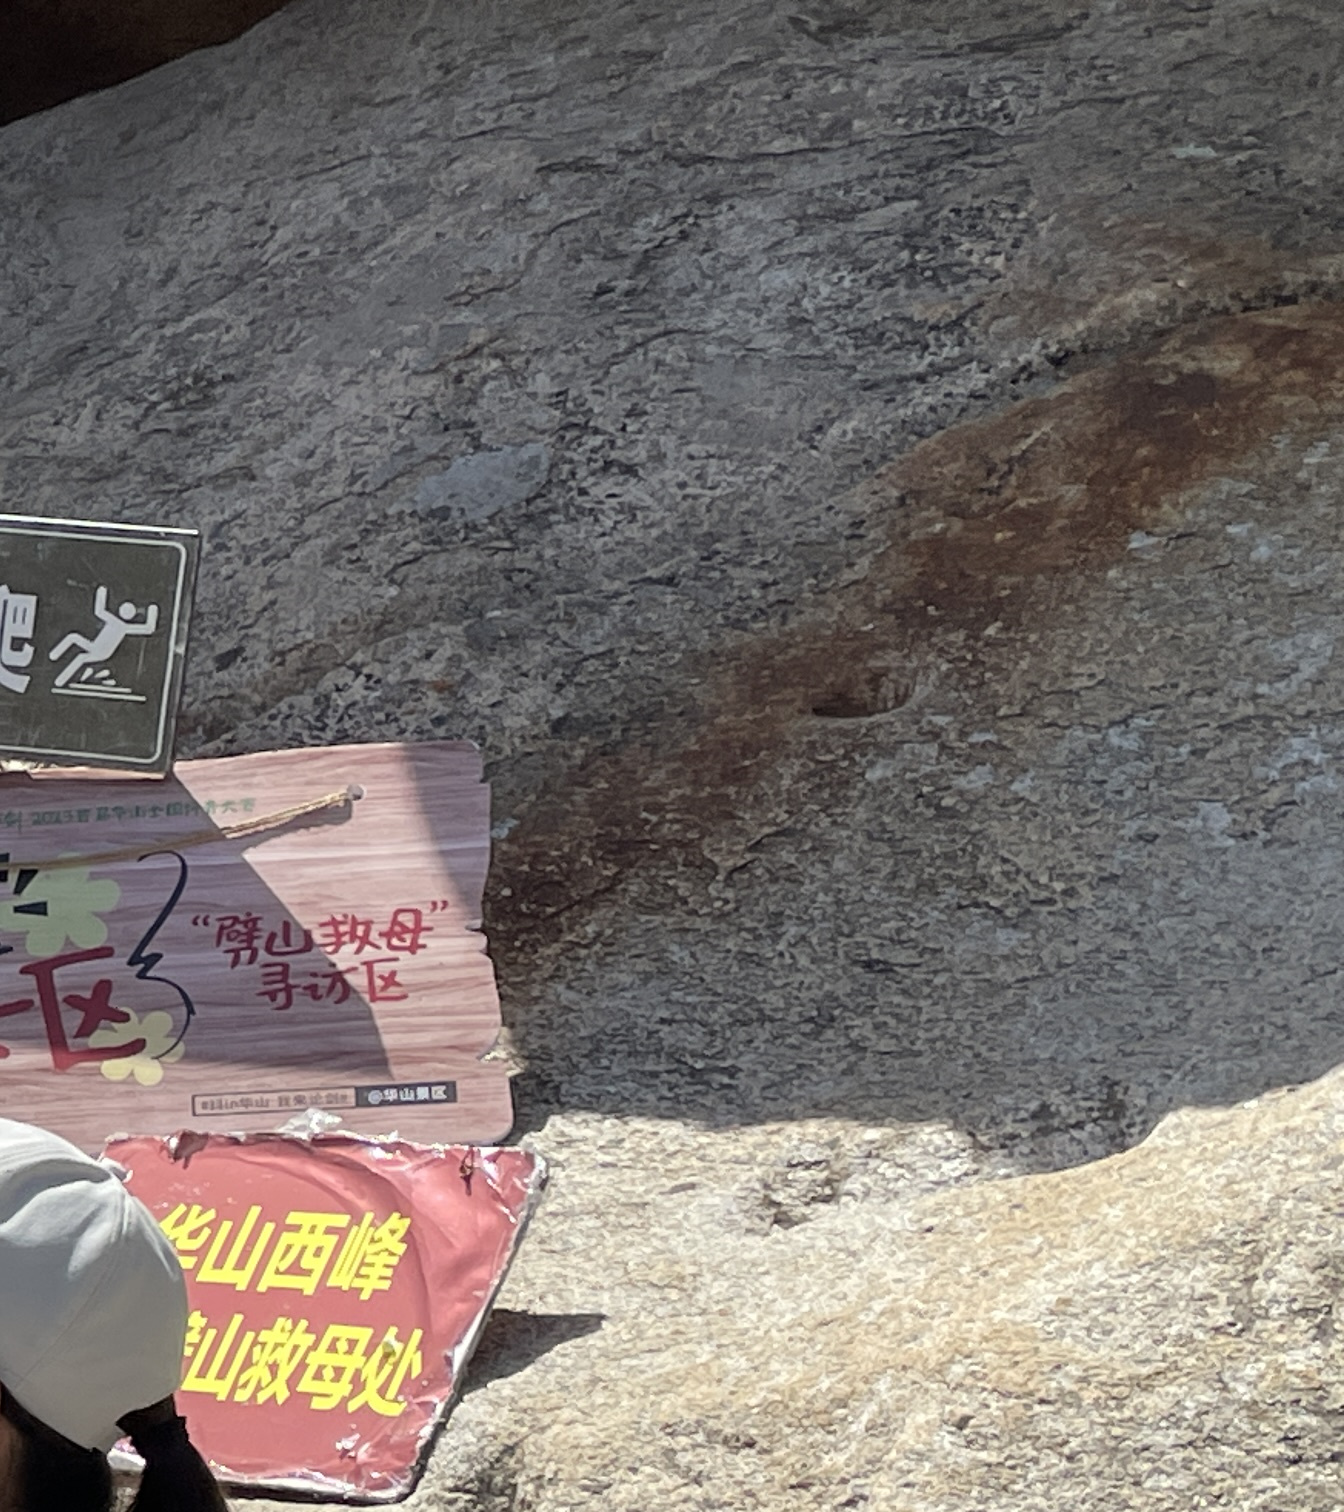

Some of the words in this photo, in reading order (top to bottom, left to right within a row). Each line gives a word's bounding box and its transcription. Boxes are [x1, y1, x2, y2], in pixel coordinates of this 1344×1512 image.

[256, 956, 409, 1011] 寻访区
[181, 1309, 423, 1417] 山救母处
